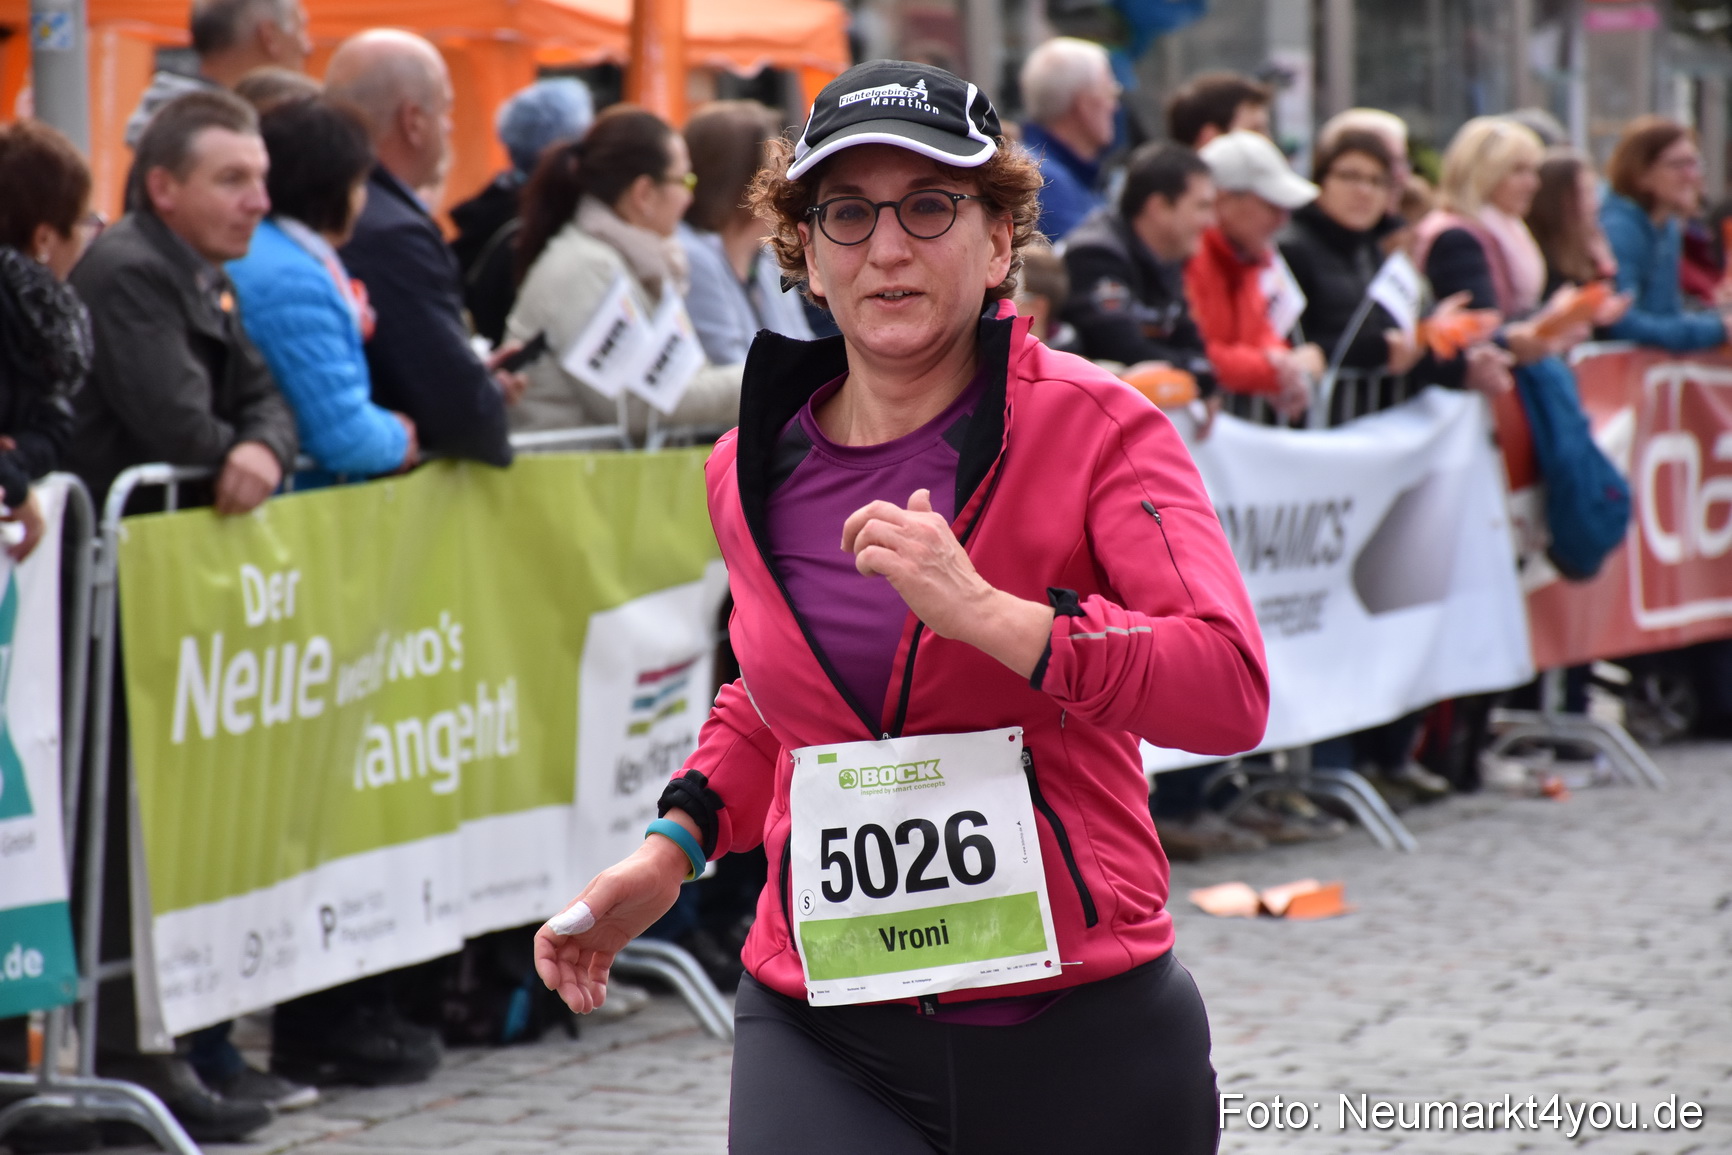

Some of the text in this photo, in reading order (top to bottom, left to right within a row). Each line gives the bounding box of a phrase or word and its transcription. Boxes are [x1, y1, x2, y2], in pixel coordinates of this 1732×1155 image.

[840, 87, 916, 106] Fichtelgebirgs
[870, 96, 940, 115] Marathon
[240, 563, 300, 628] Der
[170, 630, 333, 745] Neue
[388, 609, 464, 682] wo's
[859, 759, 944, 788] BOCK
[860, 780, 945, 796] inspired by smart concepts
[820, 810, 996, 903] 5026
[803, 896, 810, 909] S
[878, 918, 950, 953] Vroni
